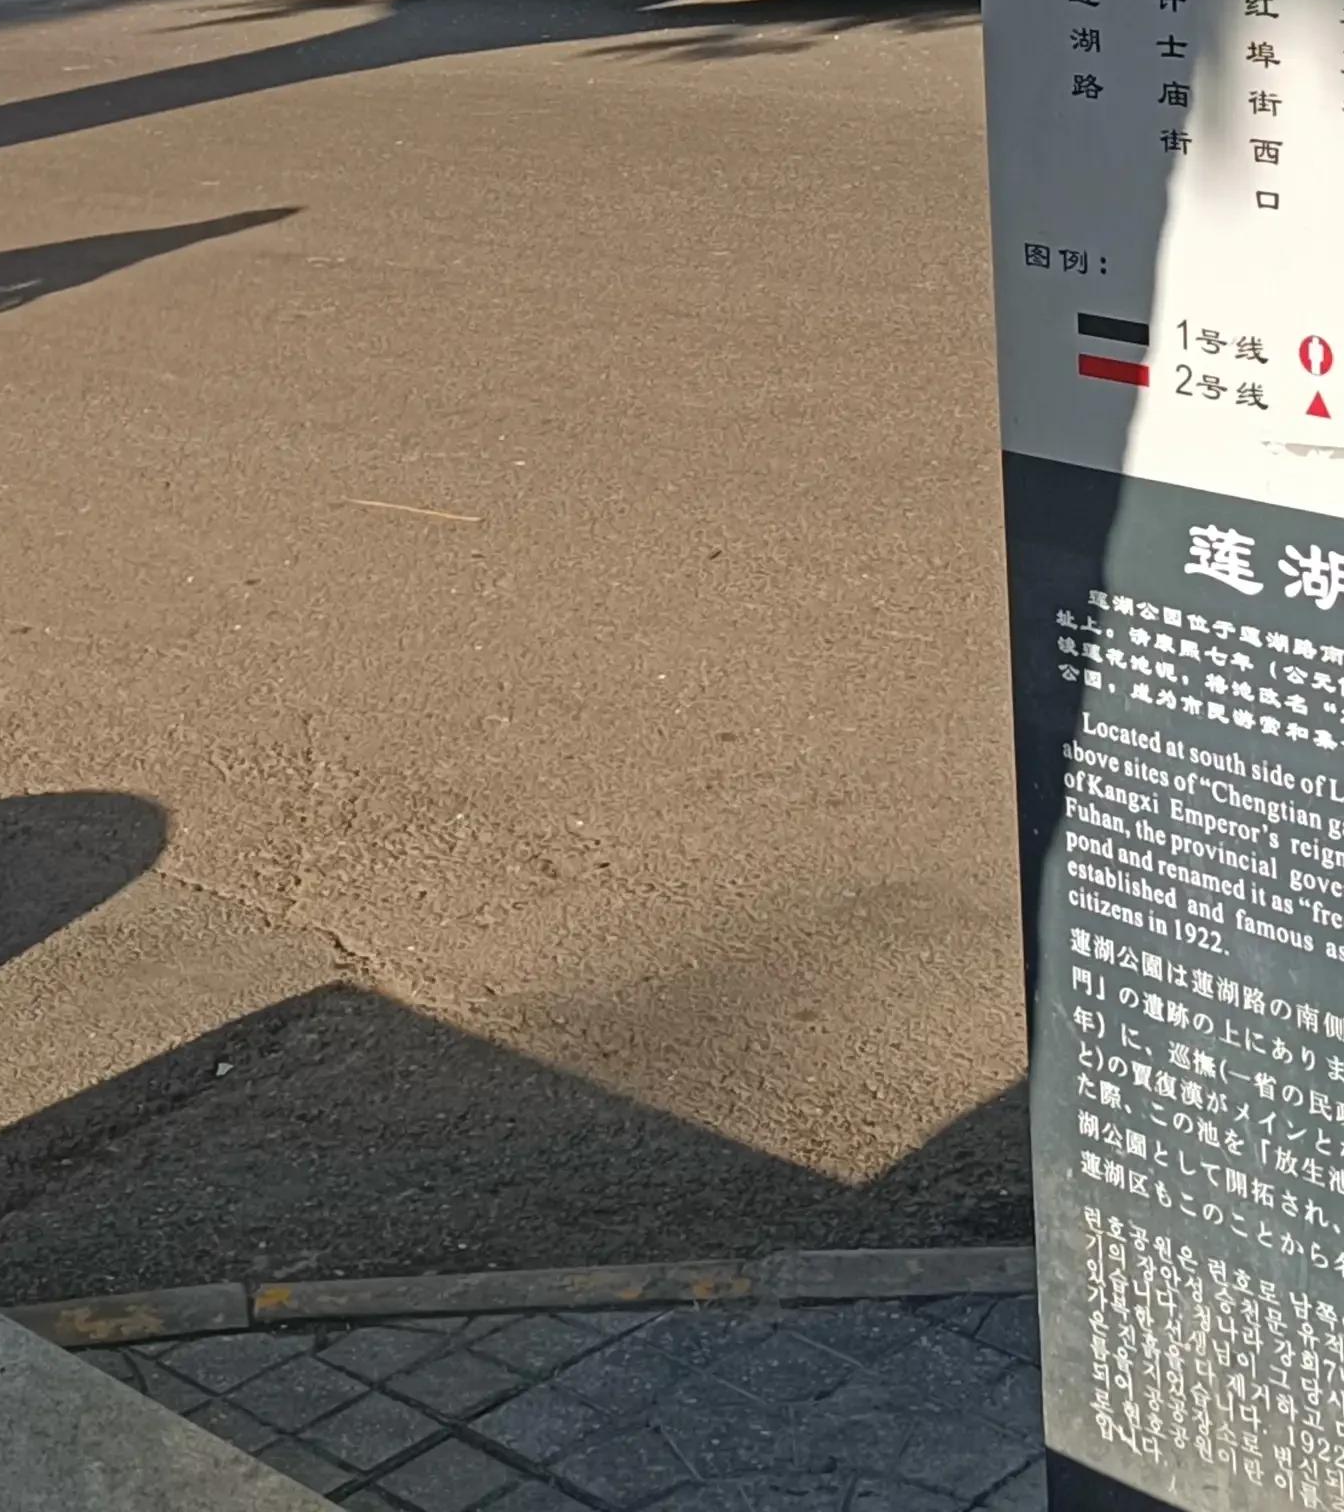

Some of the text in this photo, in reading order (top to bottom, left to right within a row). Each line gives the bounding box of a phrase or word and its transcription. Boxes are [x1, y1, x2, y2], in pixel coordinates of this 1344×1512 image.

[1176, 318, 1269, 365] 1号线
[1174, 362, 1269, 411] 2号线
[1061, 738, 1120, 773] above
[1122, 755, 1170, 788] sites
[1172, 770, 1199, 795] of
[1198, 775, 1323, 831] “Chengtian
[1081, 710, 1162, 754] Located
[1164, 739, 1185, 760] at
[1188, 746, 1247, 778] south
[1250, 758, 1296, 790] side
[1299, 773, 1327, 798] of
[1062, 768, 1087, 793] of
[1085, 772, 1159, 815] Kangxi
[1168, 796, 1280, 849] Emperor’s
[1063, 794, 1131, 839] Fuhan,
[1134, 818, 1166, 846] the
[1169, 832, 1278, 880] provincial
[1064, 829, 1114, 860] pond
[1117, 846, 1154, 873] and
[1156, 858, 1246, 901] renamed
[1250, 880, 1267, 907] it
[1270, 893, 1294, 915] as
[1065, 858, 1178, 909] established
[1186, 897, 1225, 924] and
[1234, 907, 1314, 952] famous
[1067, 885, 1230, 956] citizens in 1922.
